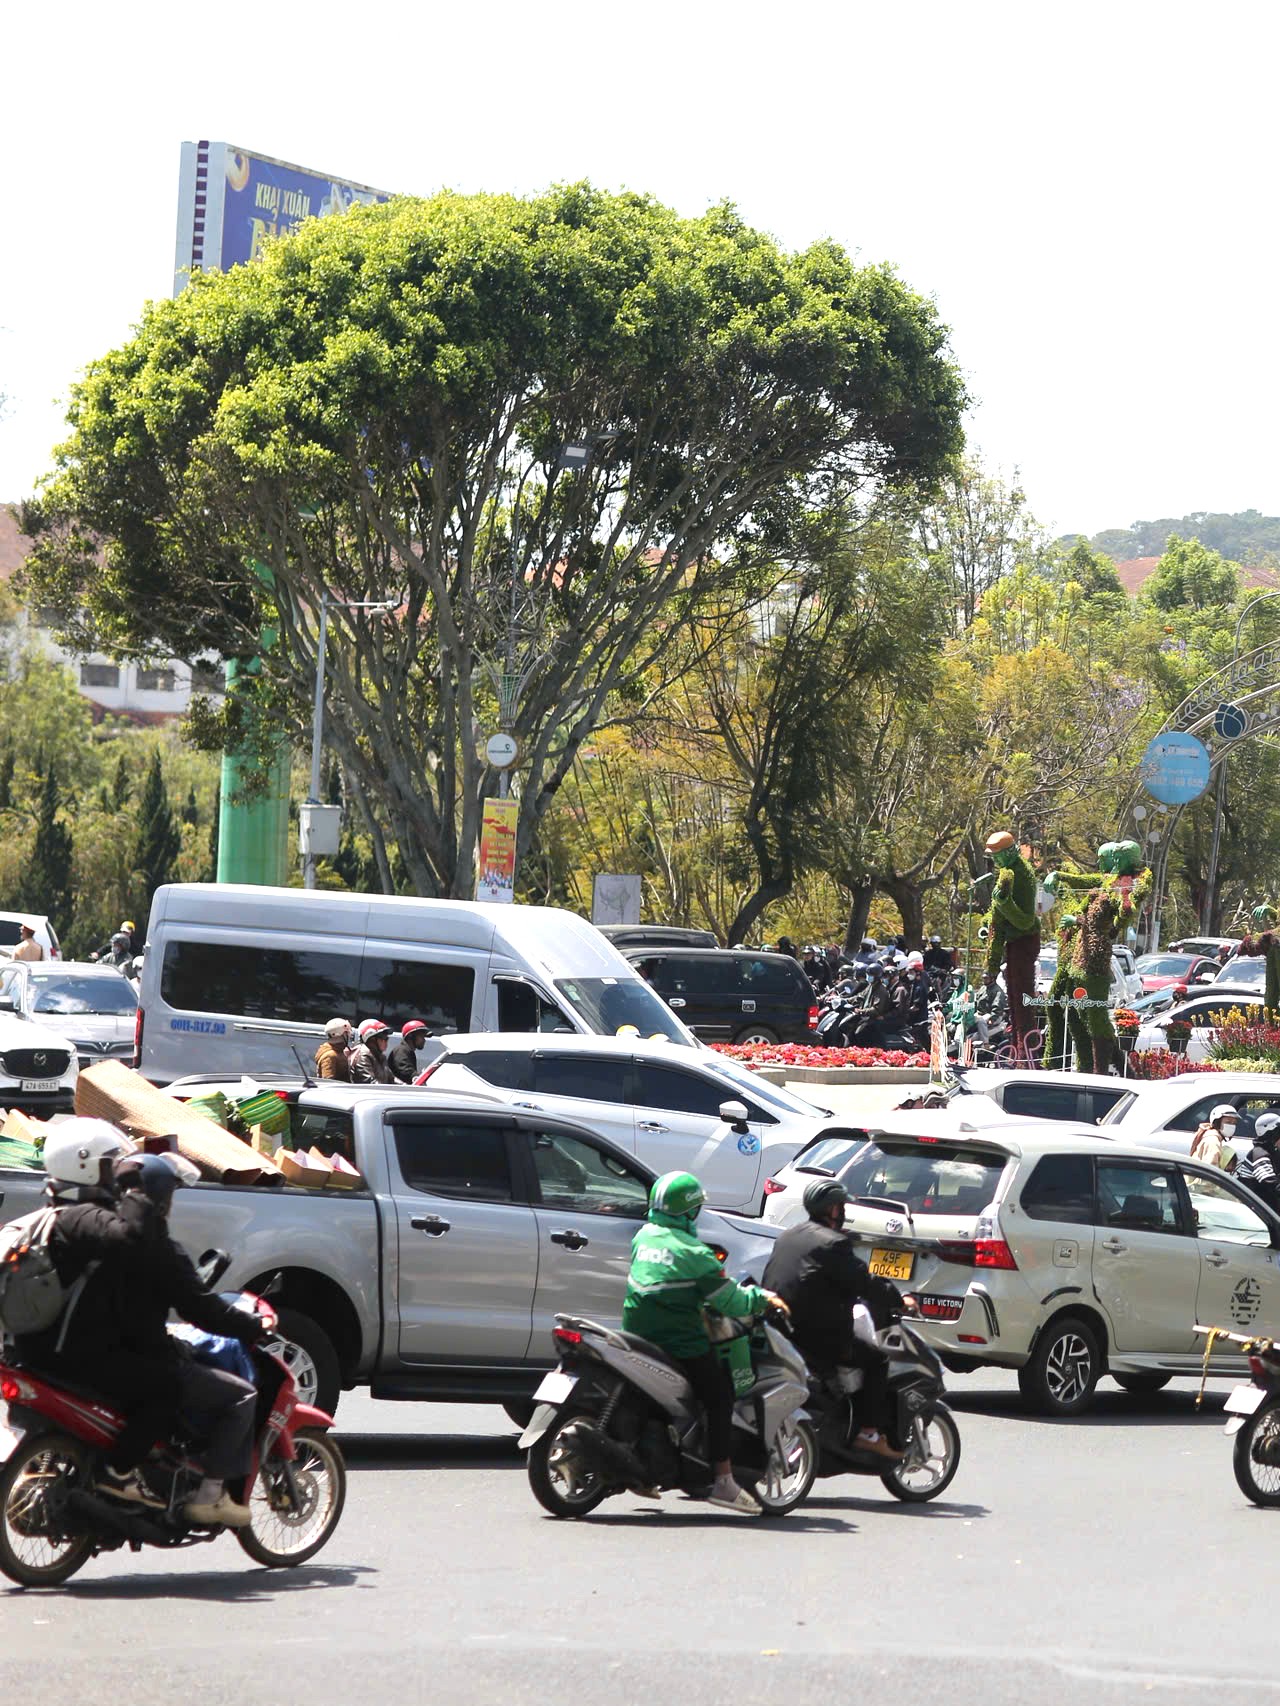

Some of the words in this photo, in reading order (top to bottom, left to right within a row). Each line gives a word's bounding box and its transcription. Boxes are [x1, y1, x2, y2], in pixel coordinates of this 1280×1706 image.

[255, 182, 281, 210] KHAI
[637, 1244, 675, 1266] Grab
[883, 1252, 902, 1264] 49F
[872, 1263, 905, 1279] 004.51
[923, 1297, 935, 1305] GET
[937, 1299, 963, 1308] VICTORY
